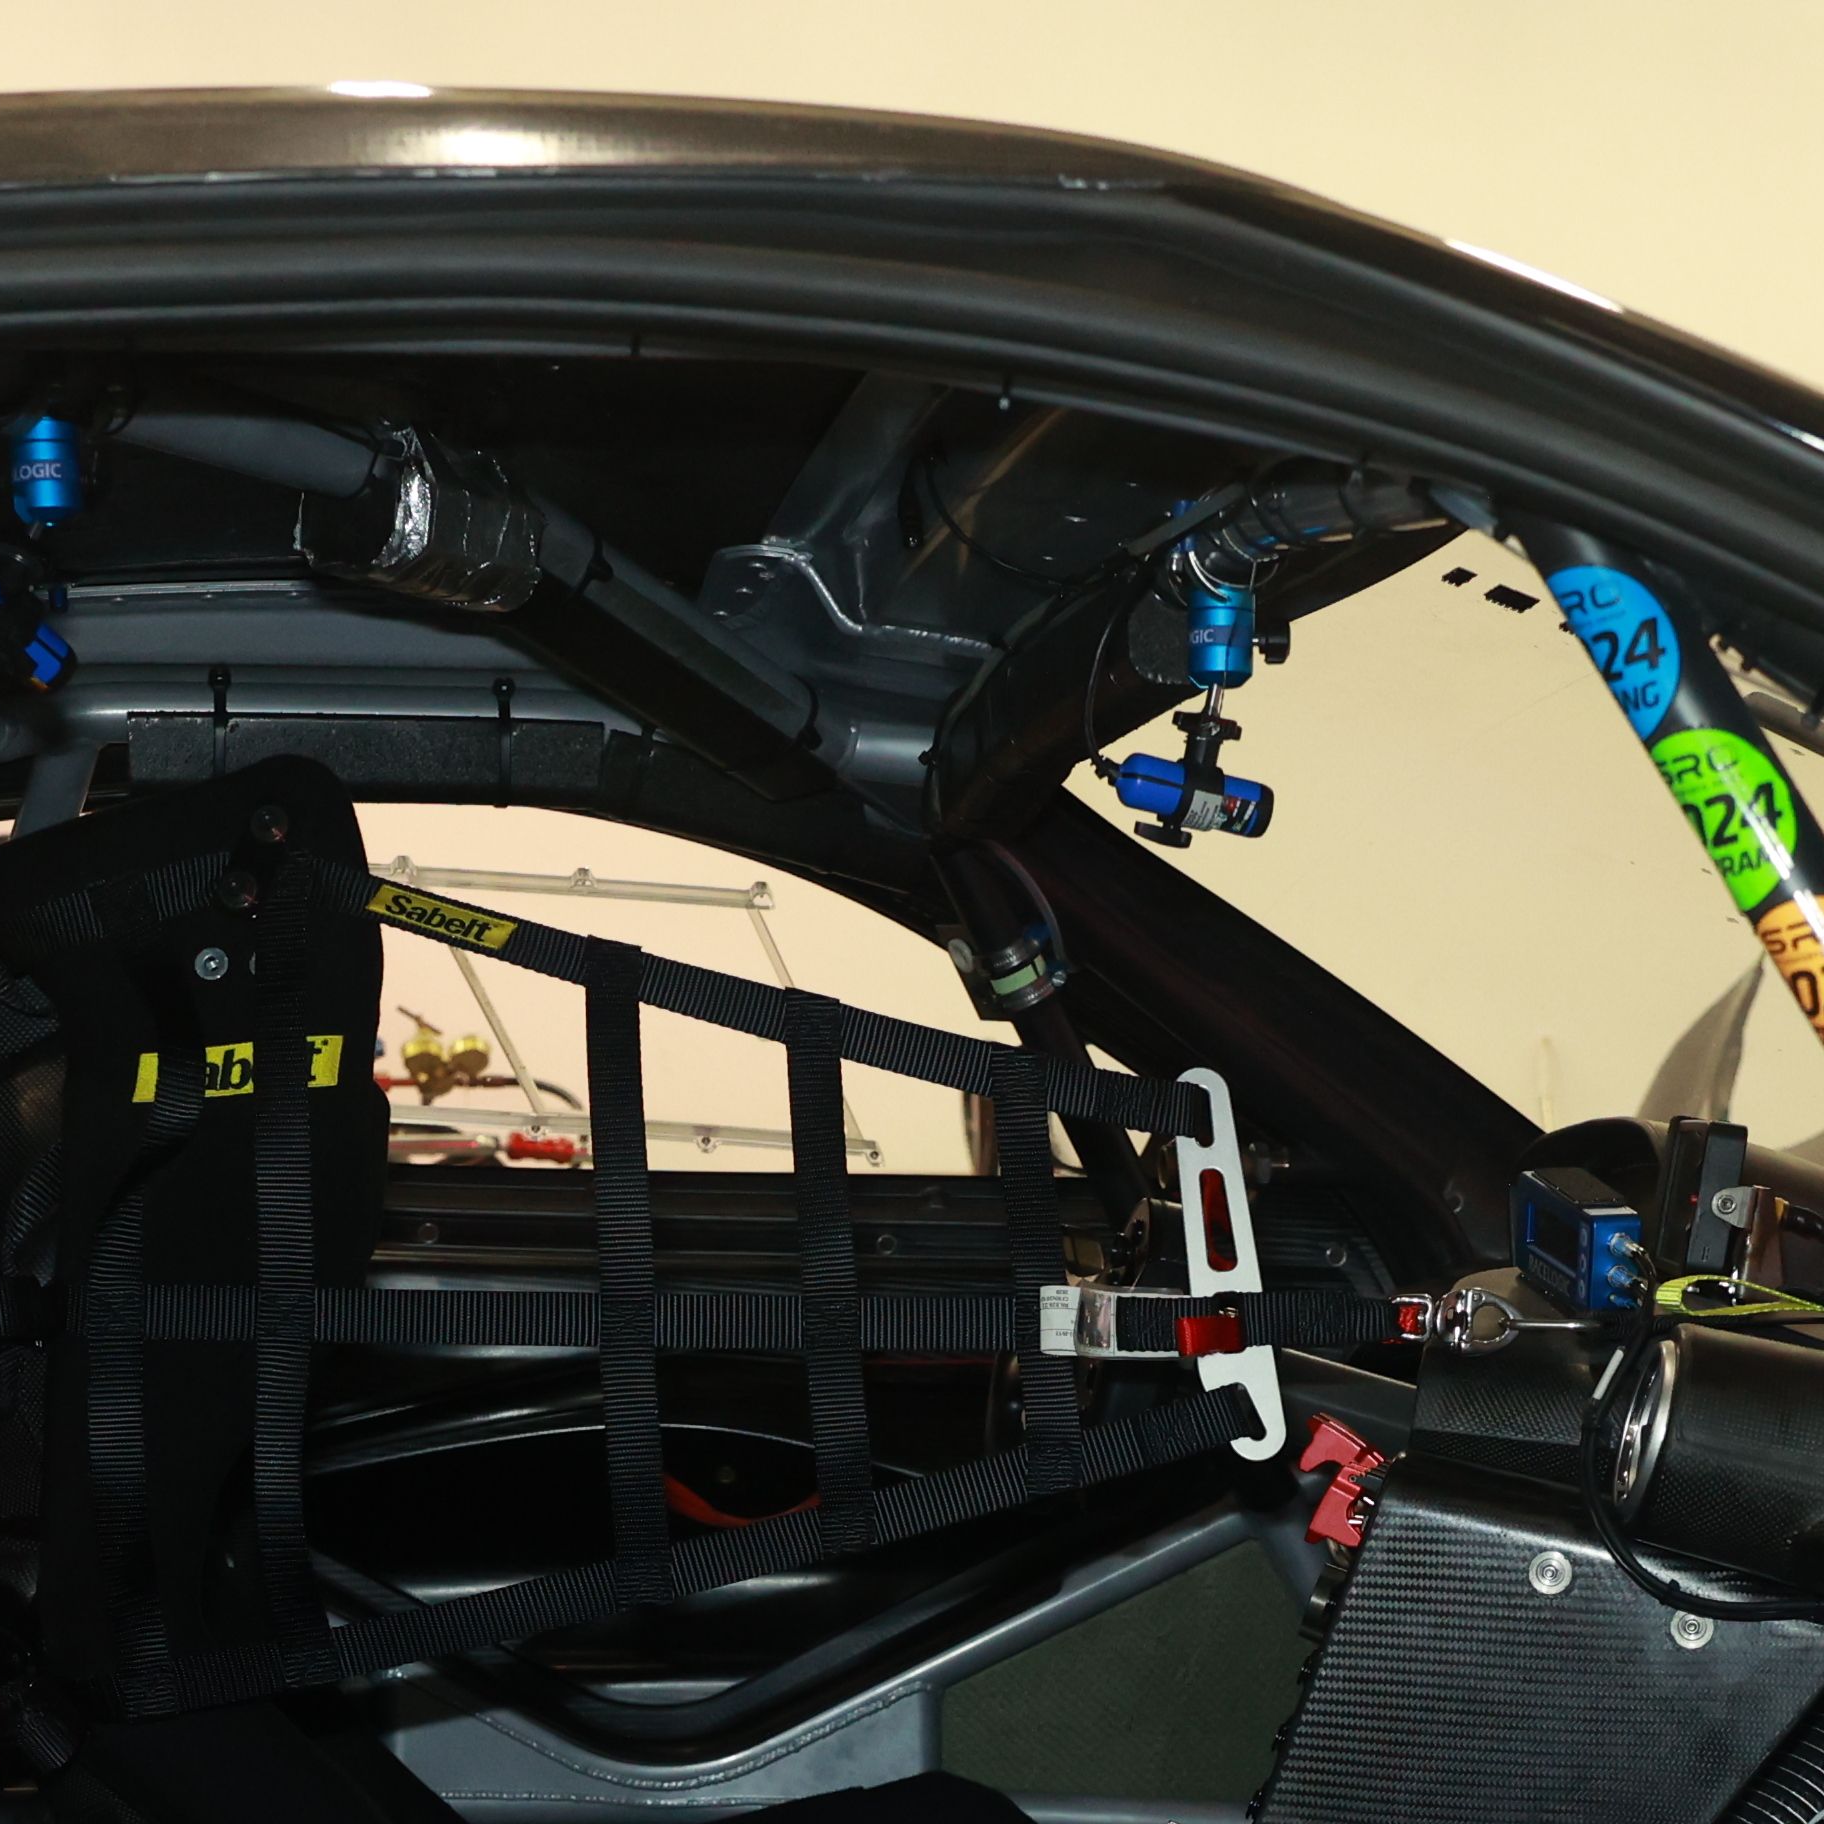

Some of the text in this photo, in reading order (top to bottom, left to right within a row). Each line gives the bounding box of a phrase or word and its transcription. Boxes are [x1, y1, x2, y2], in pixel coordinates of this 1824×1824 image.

[12, 462, 62, 481] LOGIC
[1582, 616, 1666, 683] 24
[384, 894, 493, 942] Sabelt
